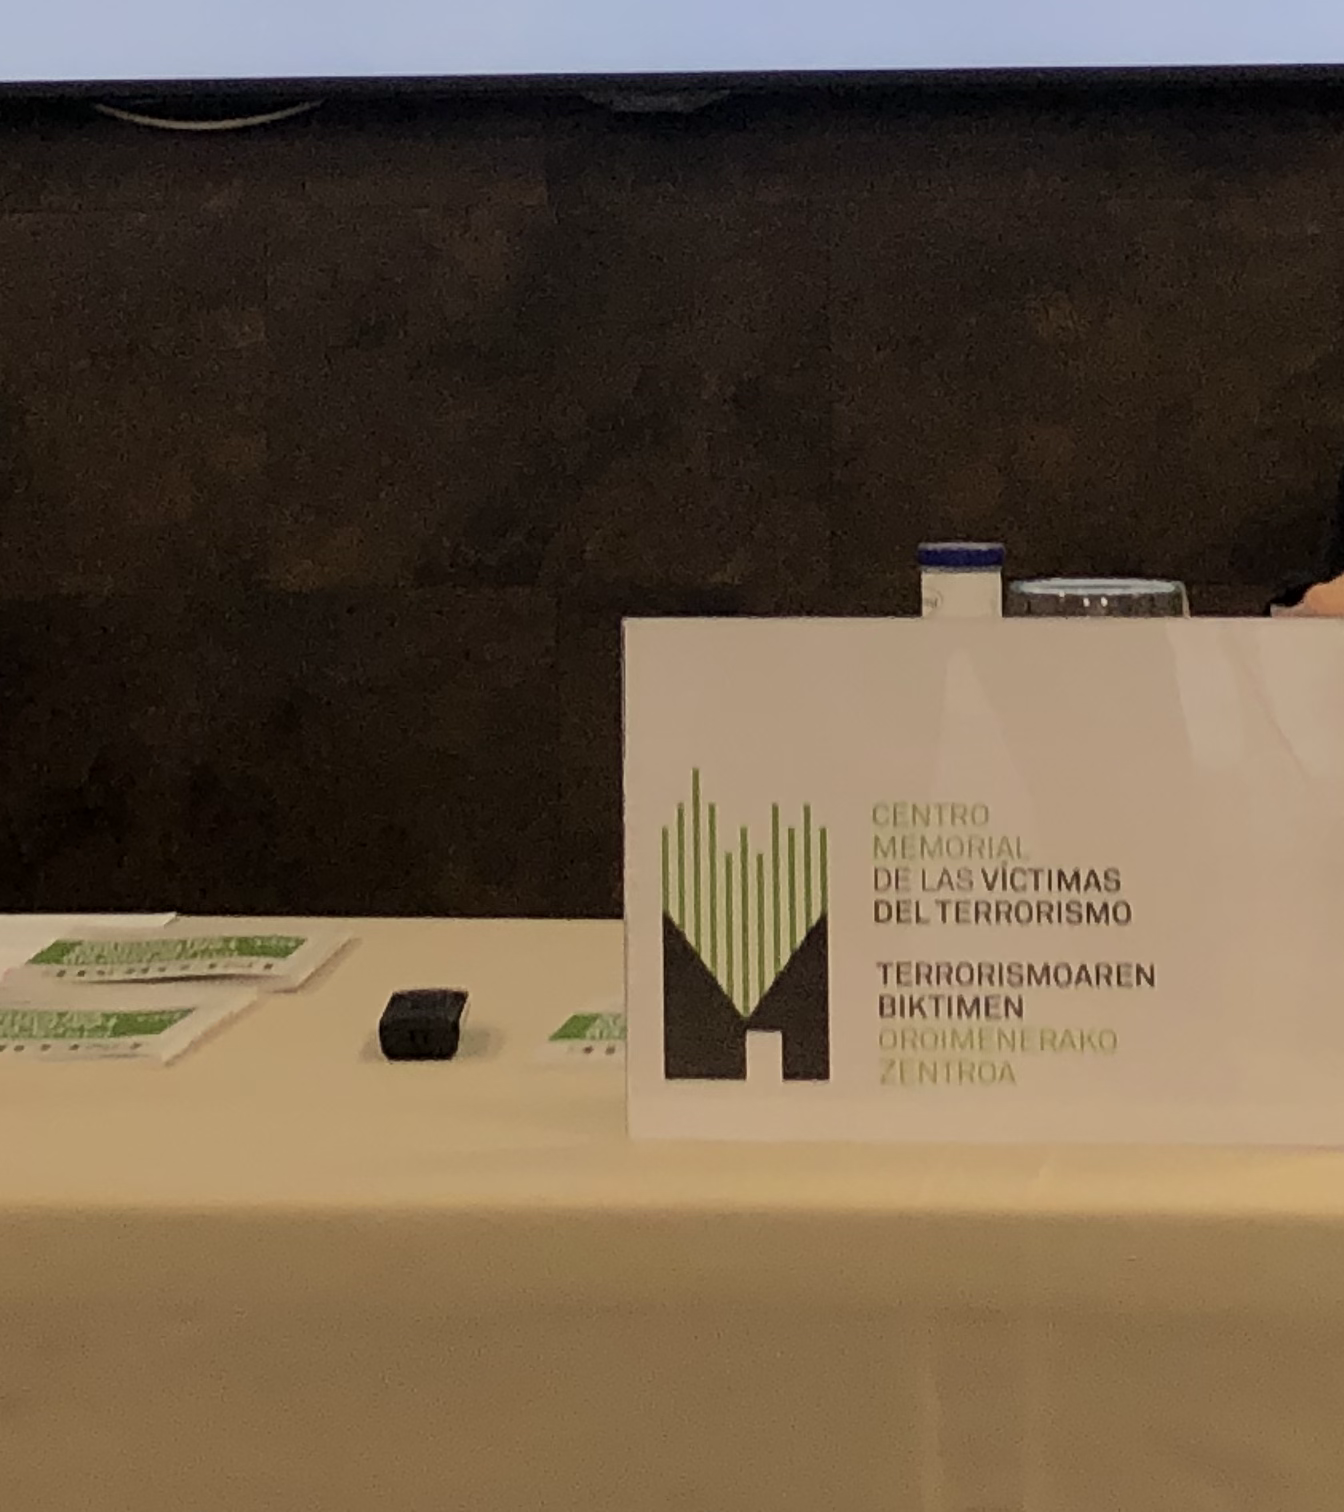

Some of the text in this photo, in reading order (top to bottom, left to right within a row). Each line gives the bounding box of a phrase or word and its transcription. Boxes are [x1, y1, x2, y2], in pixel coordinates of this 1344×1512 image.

[872, 802, 990, 828] CENTRO
[872, 834, 1031, 860] MEMORIAL
[873, 859, 1122, 893] DE LAS VÍCTIMAS
[873, 899, 1133, 926] DEL TERRORISMO
[877, 961, 1156, 988] TERRORISMOAREN
[878, 994, 1025, 1019] BIKTIMEN
[878, 1027, 1120, 1053] OROIMENERAKO
[880, 1060, 1017, 1086] ZENTROA
